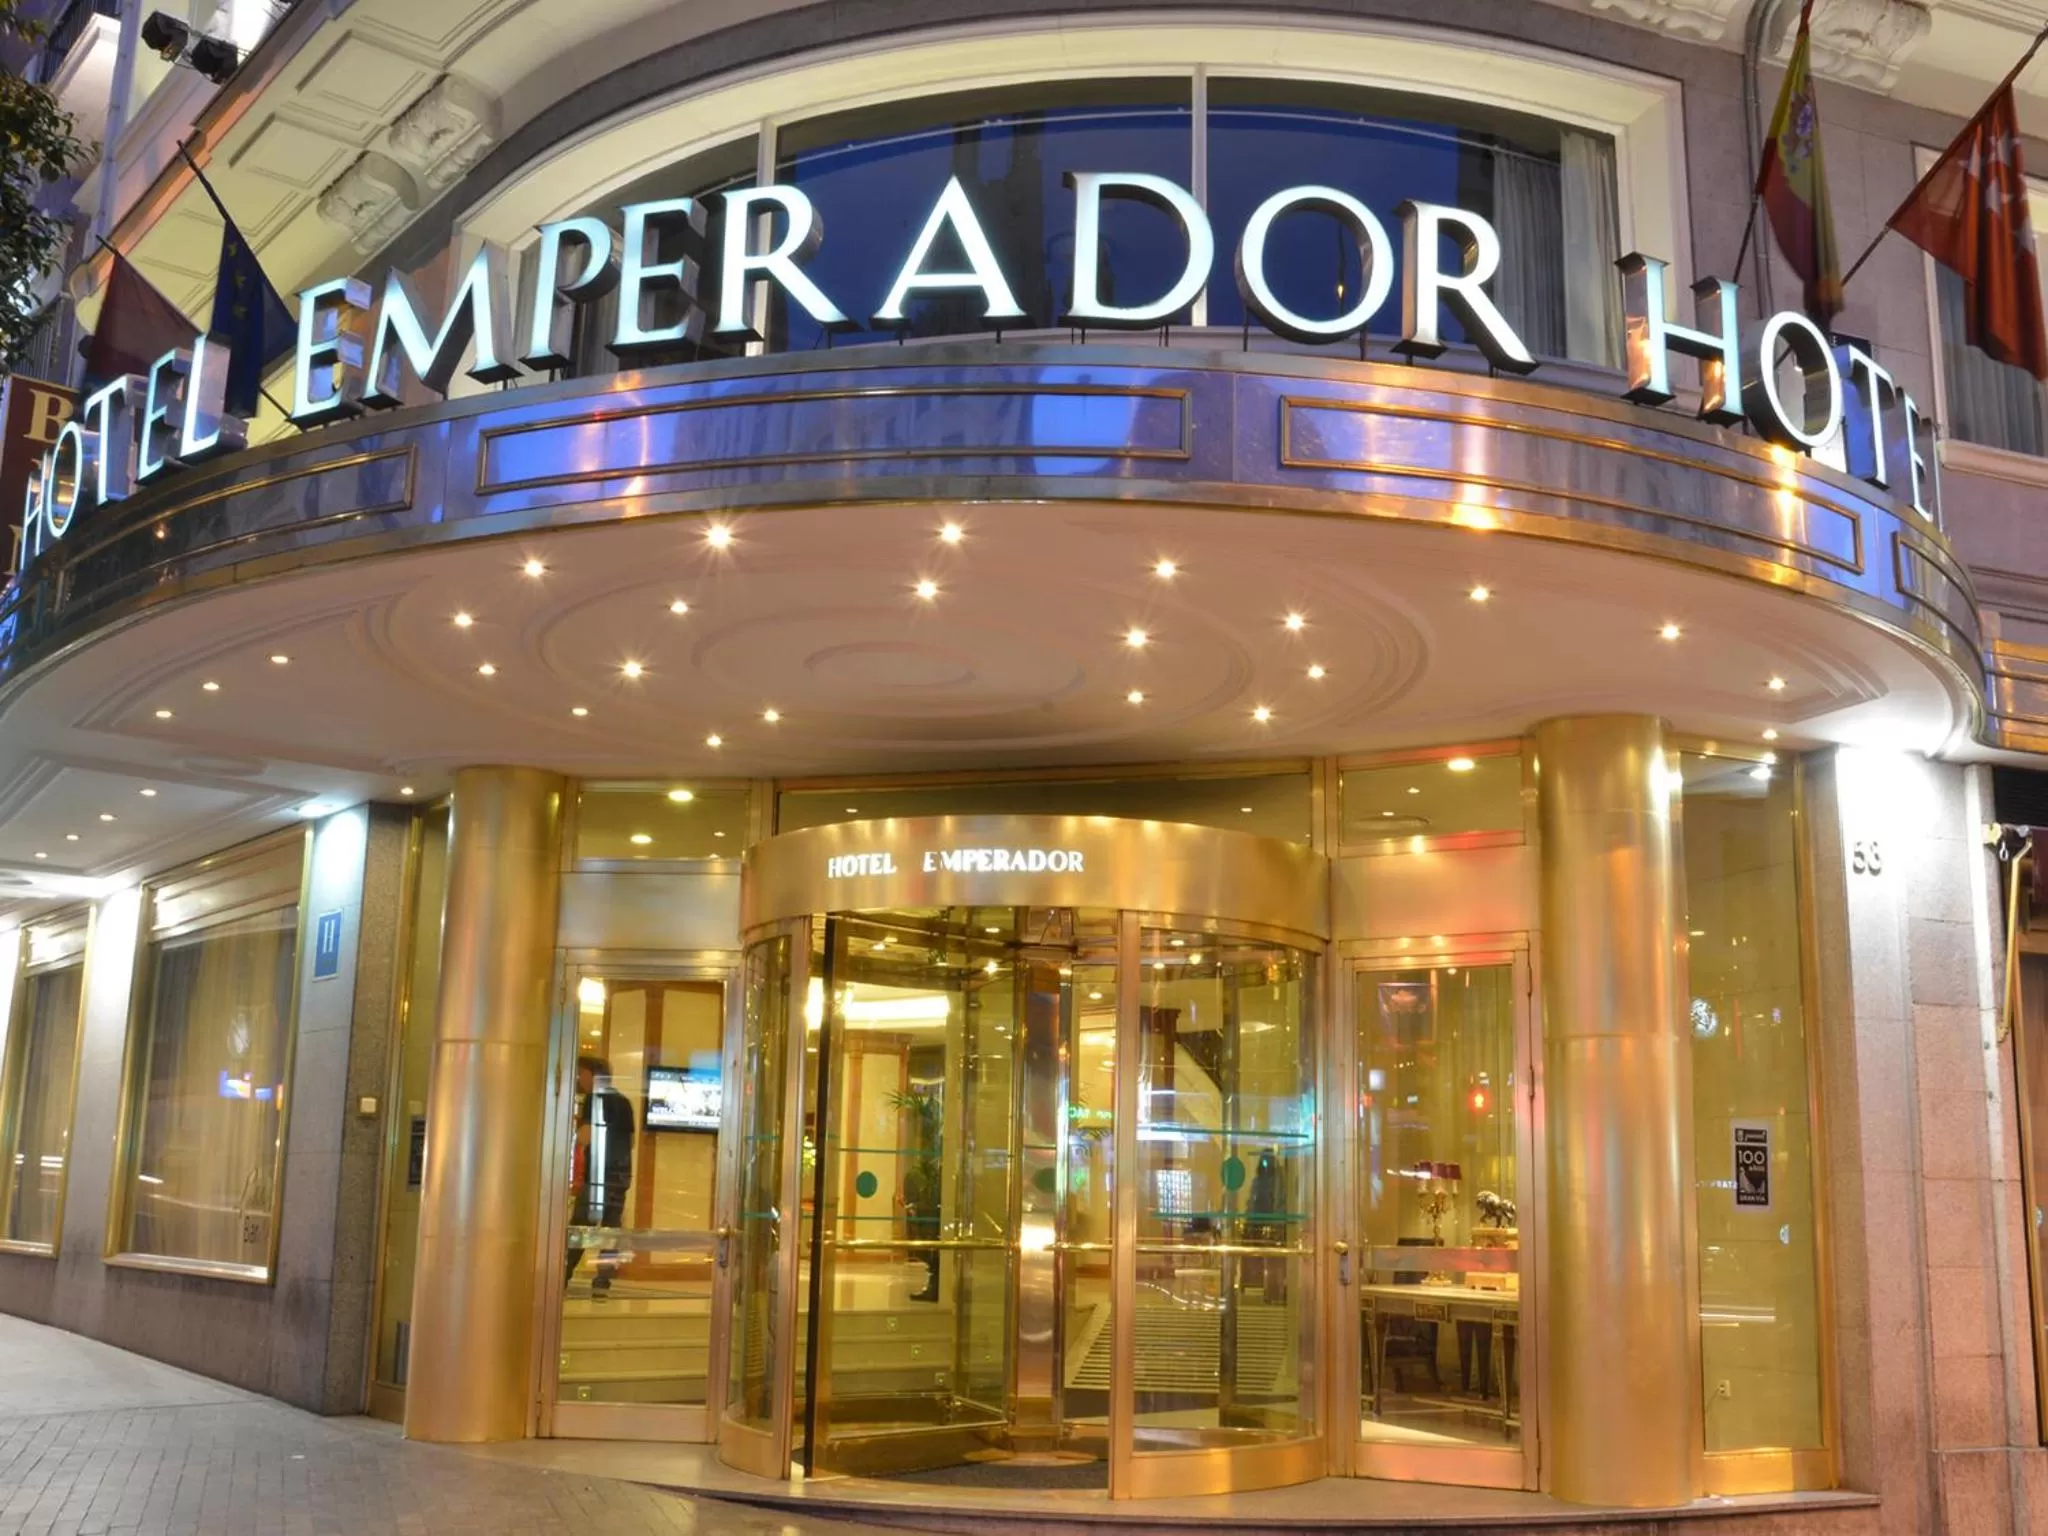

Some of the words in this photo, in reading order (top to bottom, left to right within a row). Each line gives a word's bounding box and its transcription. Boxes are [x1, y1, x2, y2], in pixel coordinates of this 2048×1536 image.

[19, 333, 222, 571] HOTEL
[289, 170, 1535, 423] EMPERADOR
[1634, 255, 1944, 534] HOTEL
[827, 853, 897, 878] HOTEL
[922, 849, 1084, 873] EMPERADOR
[1738, 1150, 1765, 1164] 100
